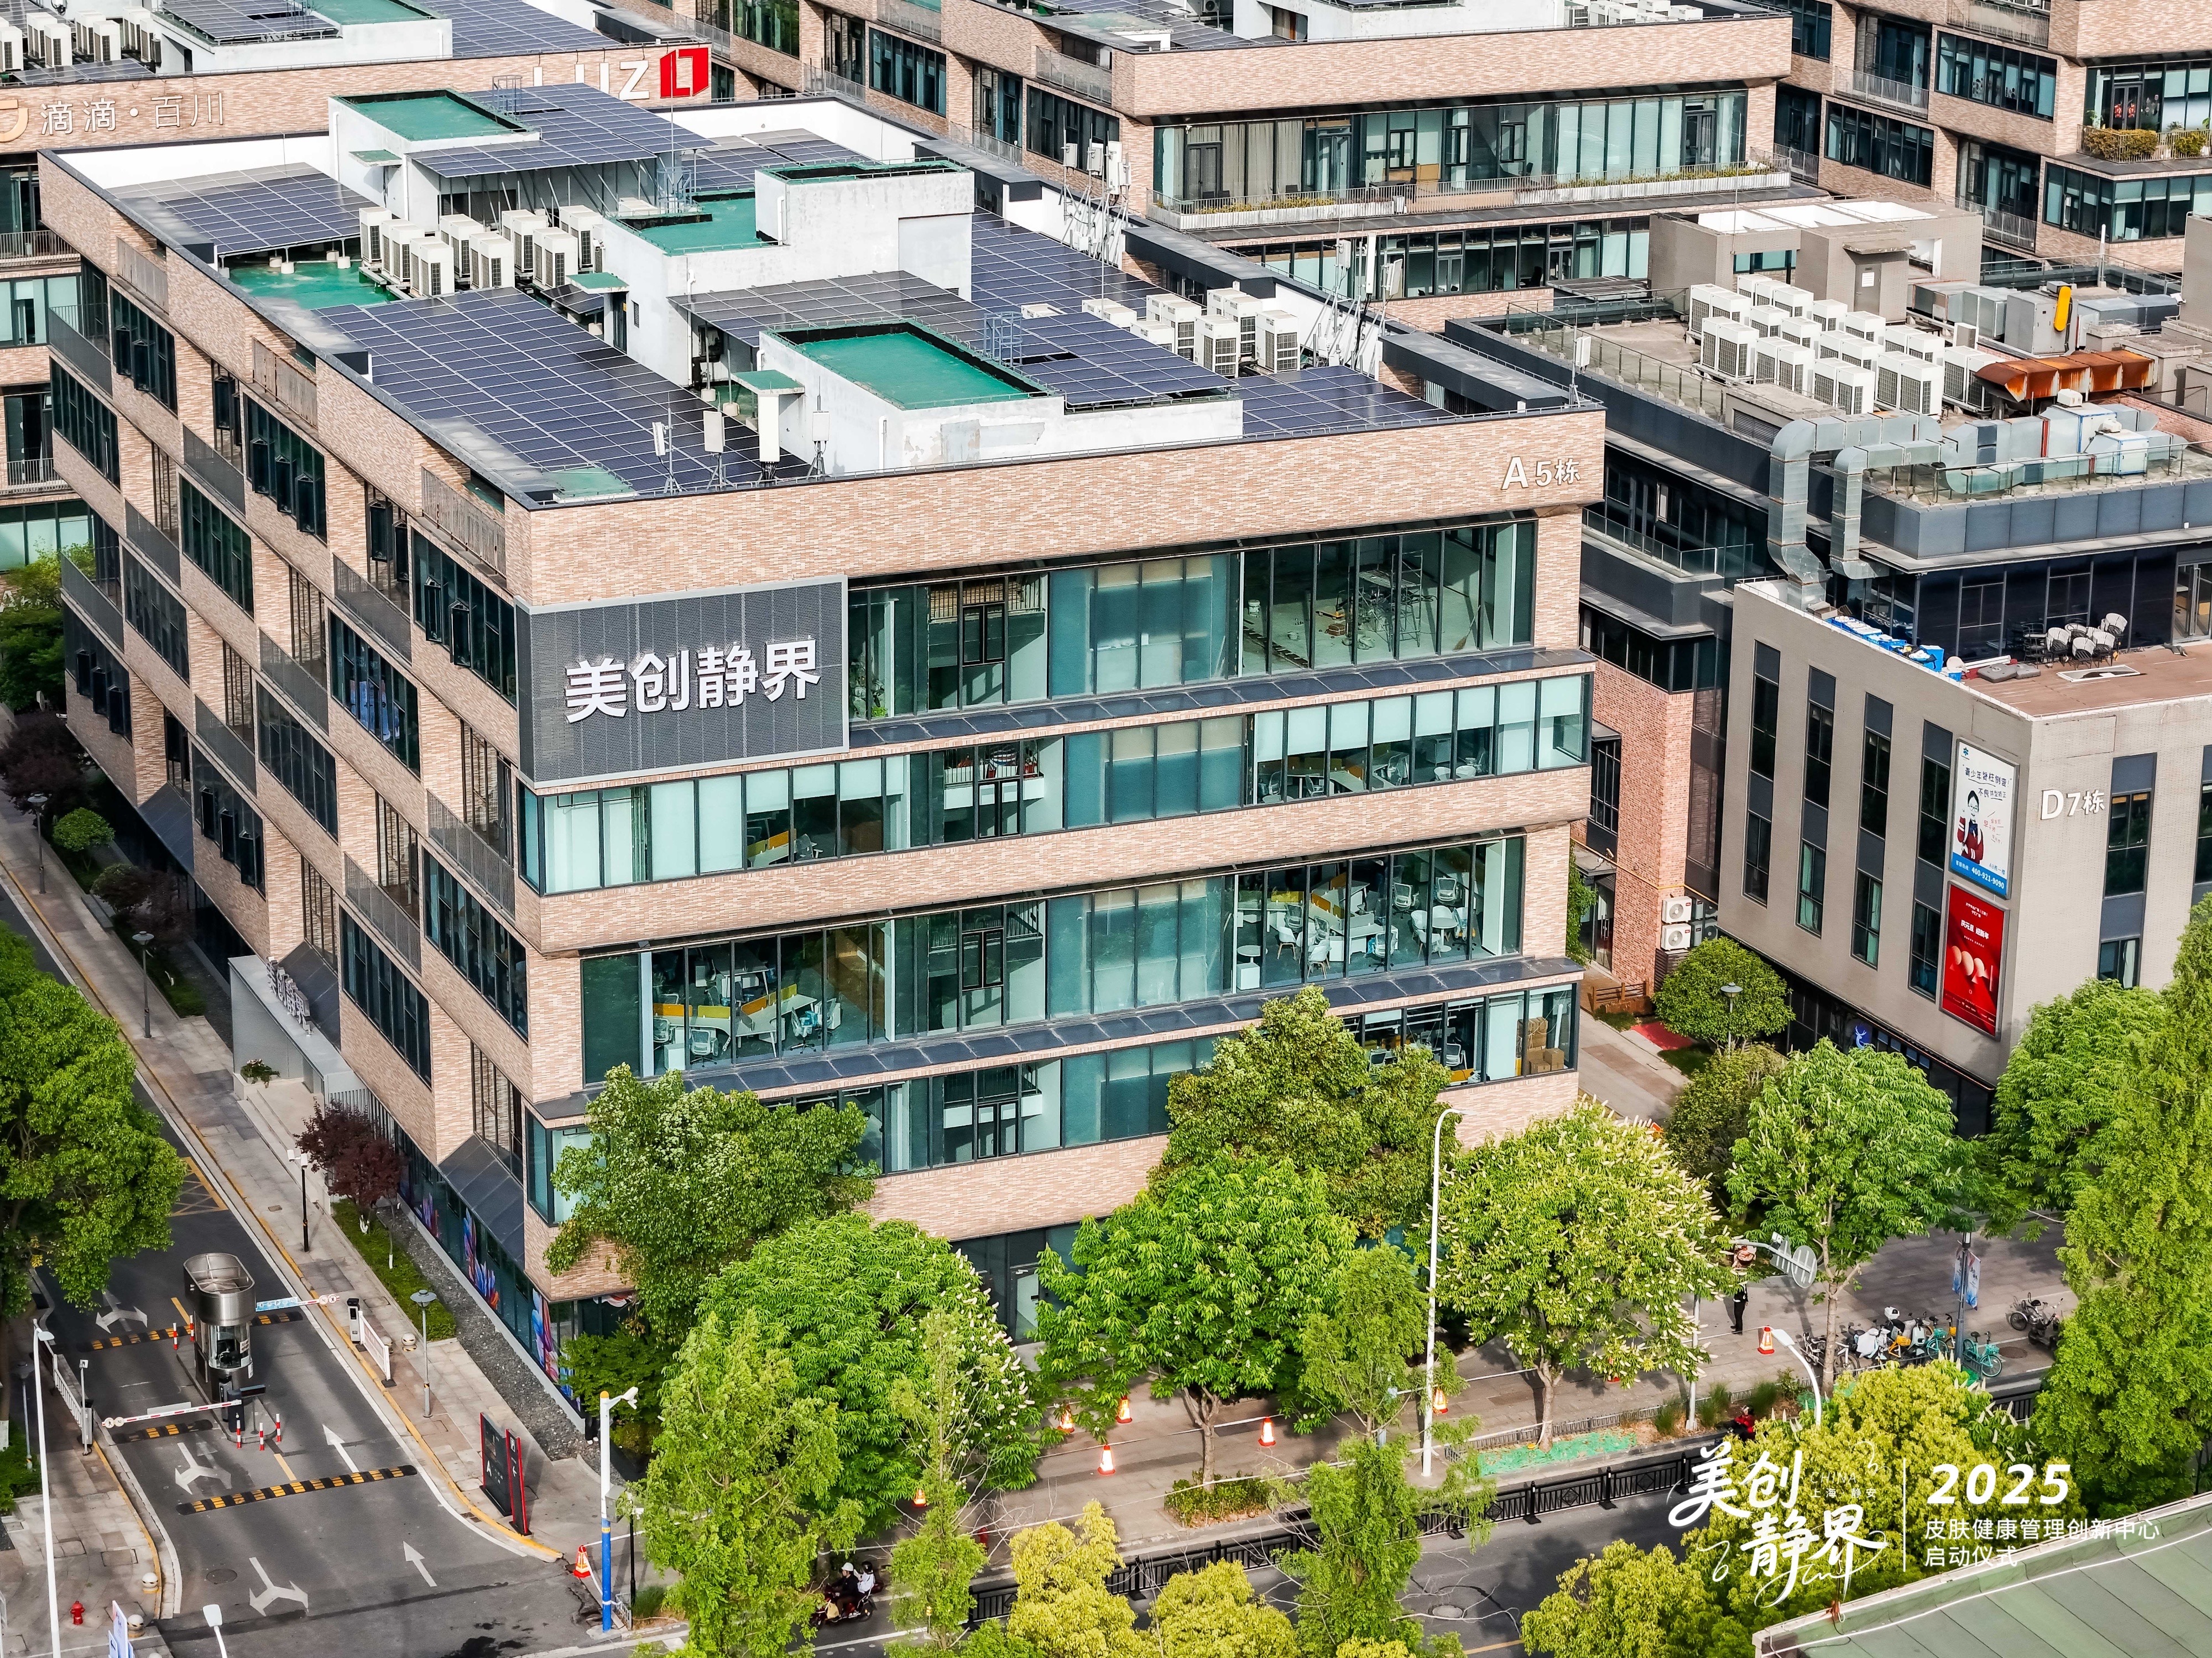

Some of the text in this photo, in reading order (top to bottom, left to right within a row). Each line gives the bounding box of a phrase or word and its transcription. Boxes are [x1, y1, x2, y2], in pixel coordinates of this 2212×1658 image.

[1500, 456, 1581, 490] A5栋
[564, 635, 821, 723] 美创静界
[2040, 789, 2105, 820] D7栋
[1971, 866, 2005, 890] 400-921-9090
